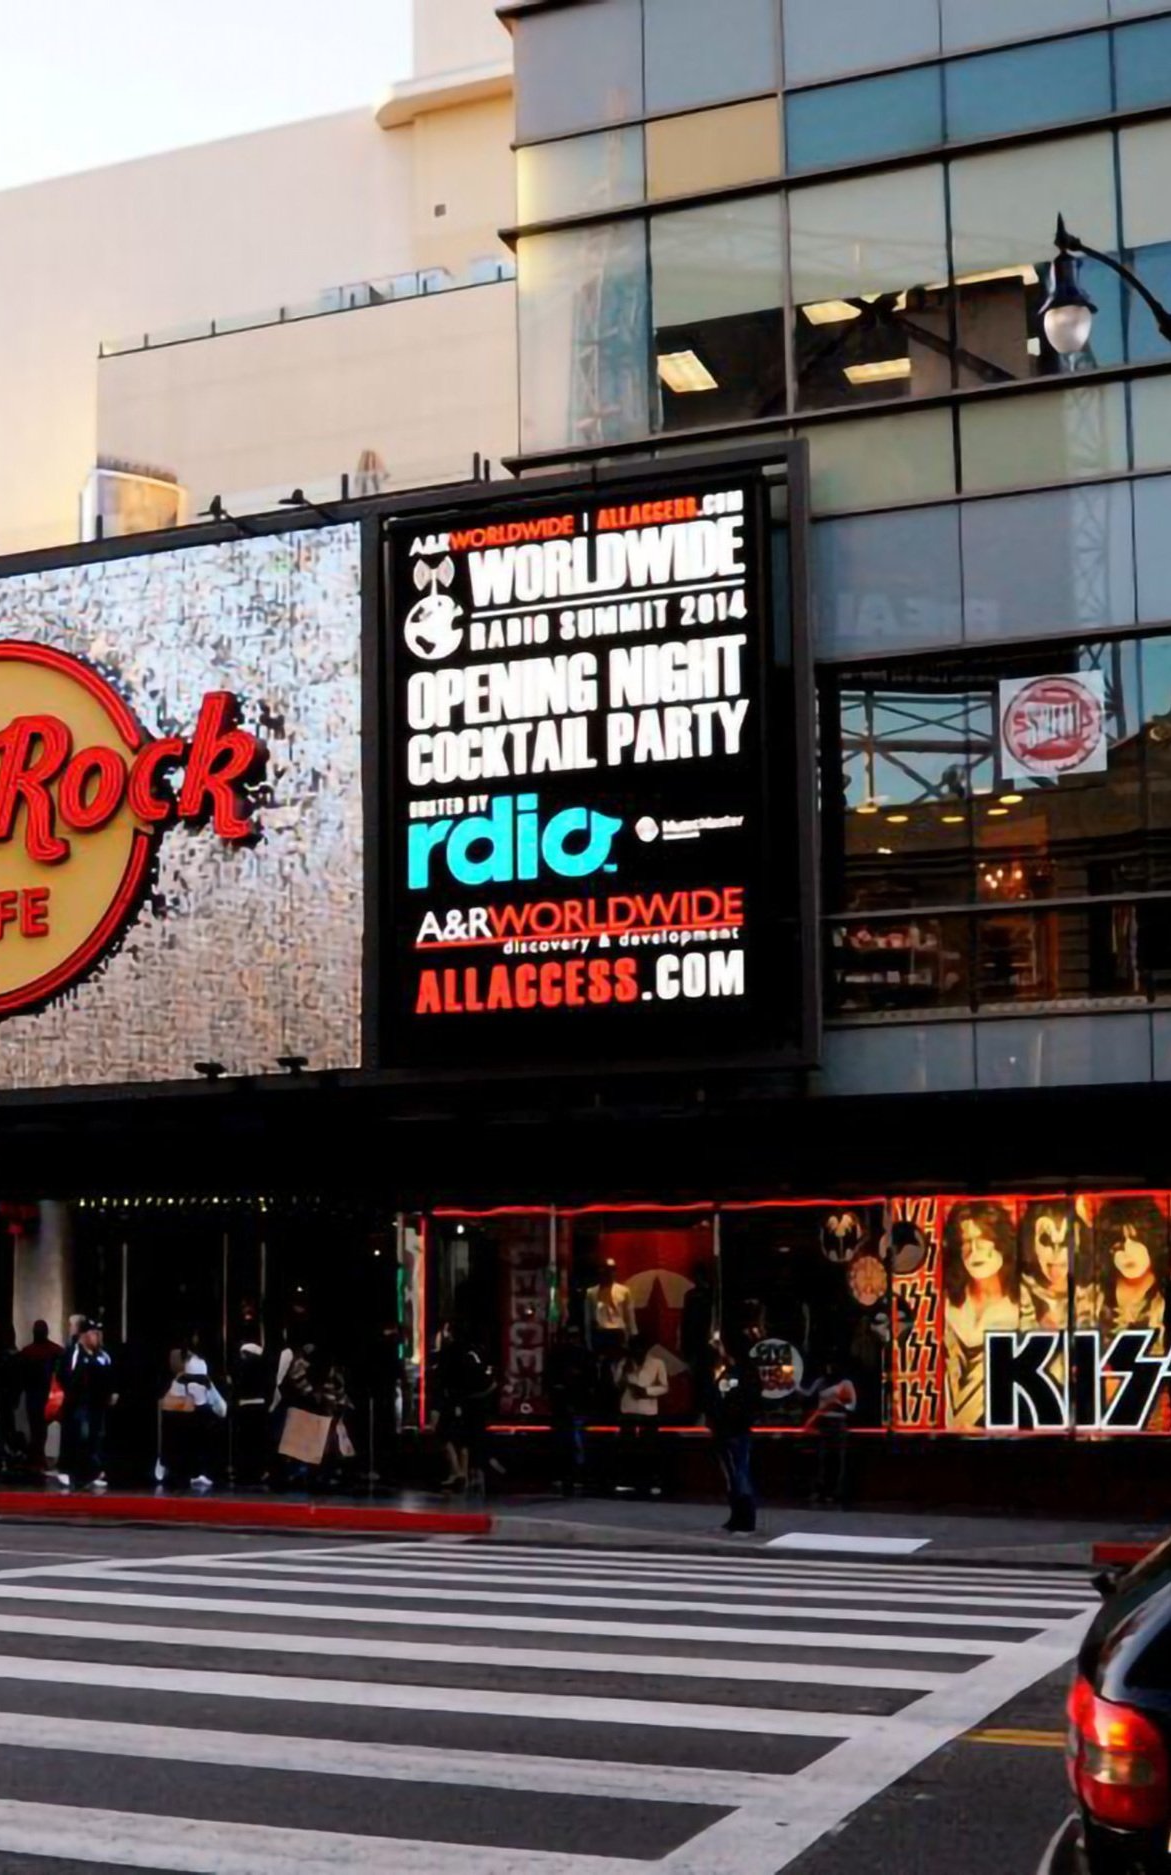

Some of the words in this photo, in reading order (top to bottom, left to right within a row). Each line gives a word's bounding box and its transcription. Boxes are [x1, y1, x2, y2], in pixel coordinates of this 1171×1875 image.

[468, 515, 746, 607] WORLDWIDE
[470, 614, 549, 651] RADIO
[560, 599, 669, 641] SUMMIT
[680, 589, 748, 626] 2014
[408, 652, 597, 730] OPENING
[609, 633, 747, 709] NIGHT
[408, 716, 598, 786] COCKTAIL
[607, 699, 750, 766] PARTY
[408, 793, 623, 890] rdio
[415, 950, 744, 1014] ALLACCESS.COM
[503, 935, 591, 955] discovery
[619, 926, 740, 947] development
[985, 1330, 1171, 1430] KIS
